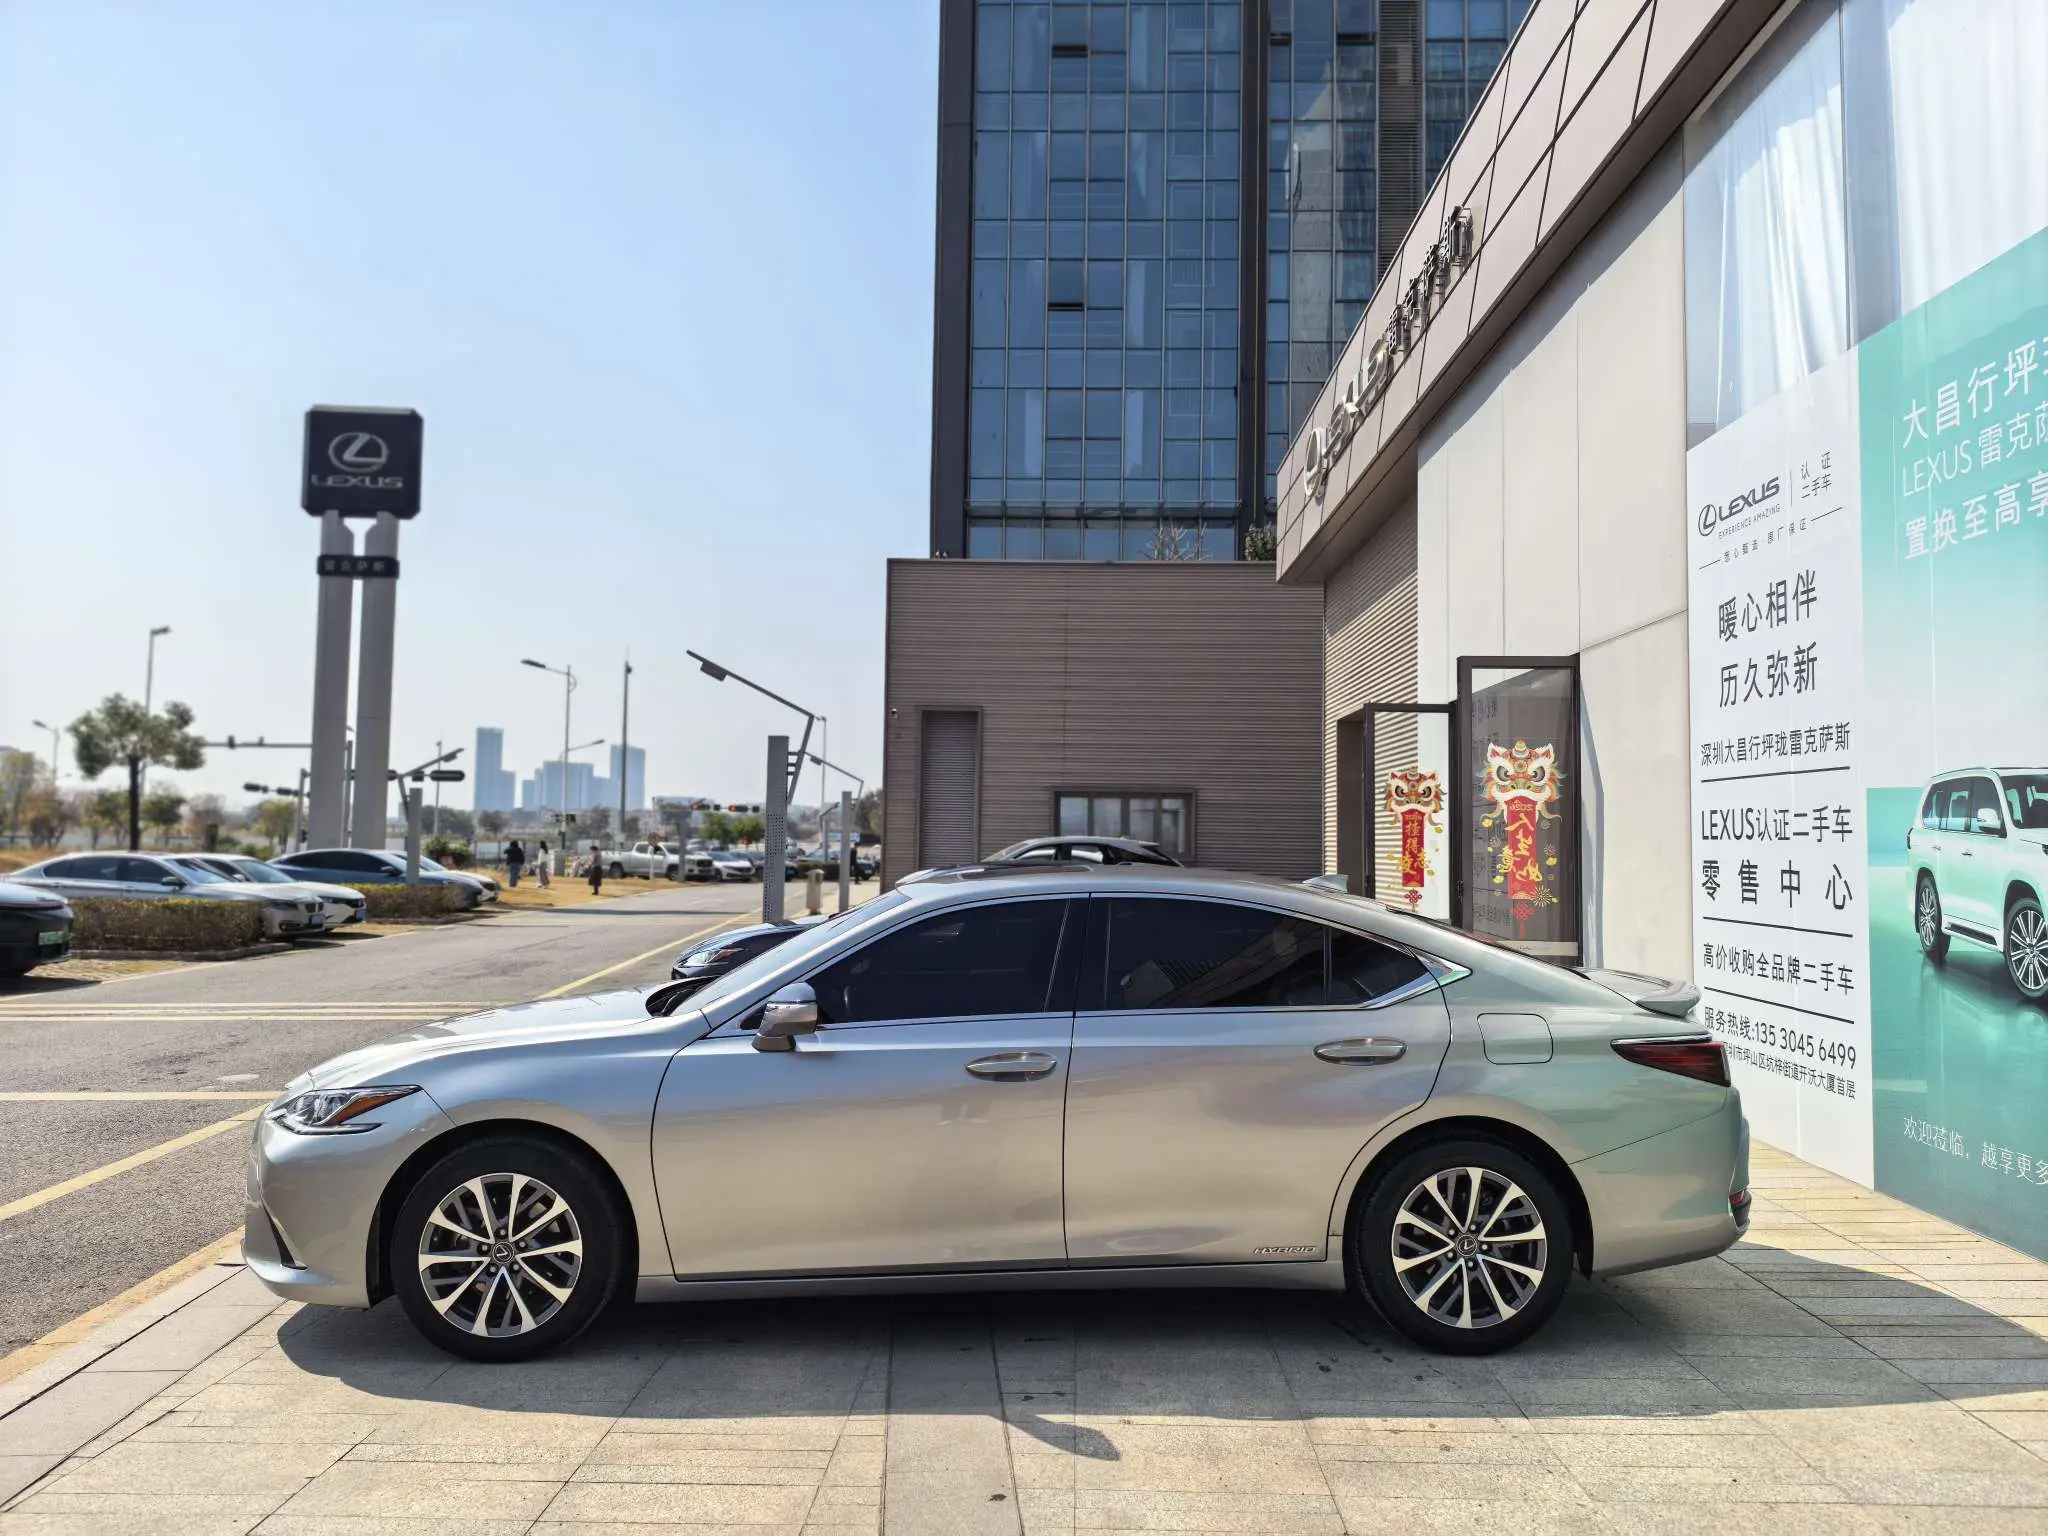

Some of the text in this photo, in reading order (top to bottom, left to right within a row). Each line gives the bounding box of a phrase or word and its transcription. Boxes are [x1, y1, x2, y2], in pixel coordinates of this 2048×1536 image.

[1902, 335, 2048, 449] 大昌行坪
[311, 474, 403, 488] LEXUS
[1801, 474, 1832, 499] 二手车
[1903, 440, 1972, 497] LEXUS
[1718, 477, 1780, 521] LEXUS
[1718, 504, 1781, 540] EXPERIENCE AMAZING
[1719, 569, 1818, 643] 暖心相伴
[1720, 642, 1818, 708] 历久弥新
[1701, 805, 1853, 842] LEXUS认证二手车
[1703, 943, 1854, 996] 高价收购全品牌二手车
[1780, 1028, 1814, 1058] 3045
[1819, 1038, 1856, 1069] 6499
[1254, 1246, 1317, 1255] HYBRID
